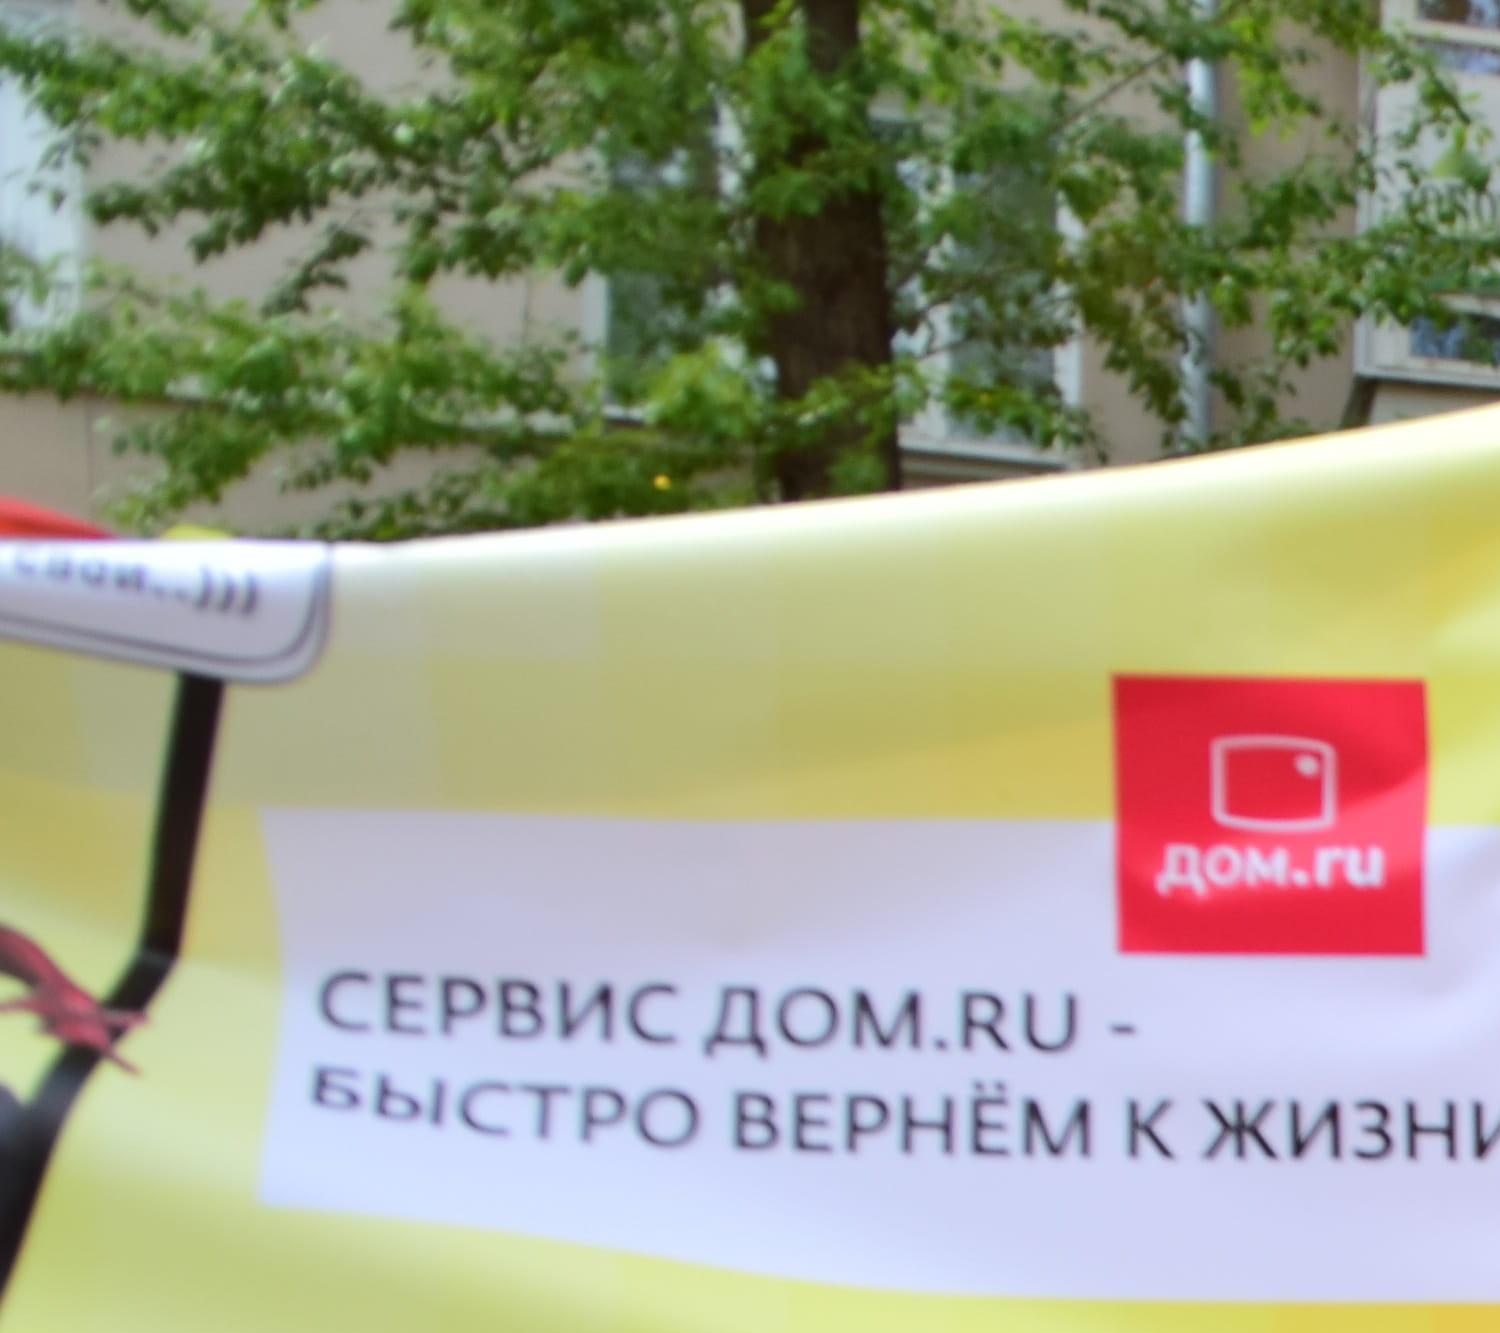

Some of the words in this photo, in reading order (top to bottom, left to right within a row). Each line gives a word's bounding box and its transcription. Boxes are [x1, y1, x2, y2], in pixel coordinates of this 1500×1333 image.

[314, 969, 680, 1046] СЕРВИС
[703, 984, 1079, 1058] ДОМ.RU
[310, 1063, 702, 1149] БЫСТРО
[730, 1079, 1093, 1159] ВЕРНЁМ
[1125, 1099, 1176, 1160] К
